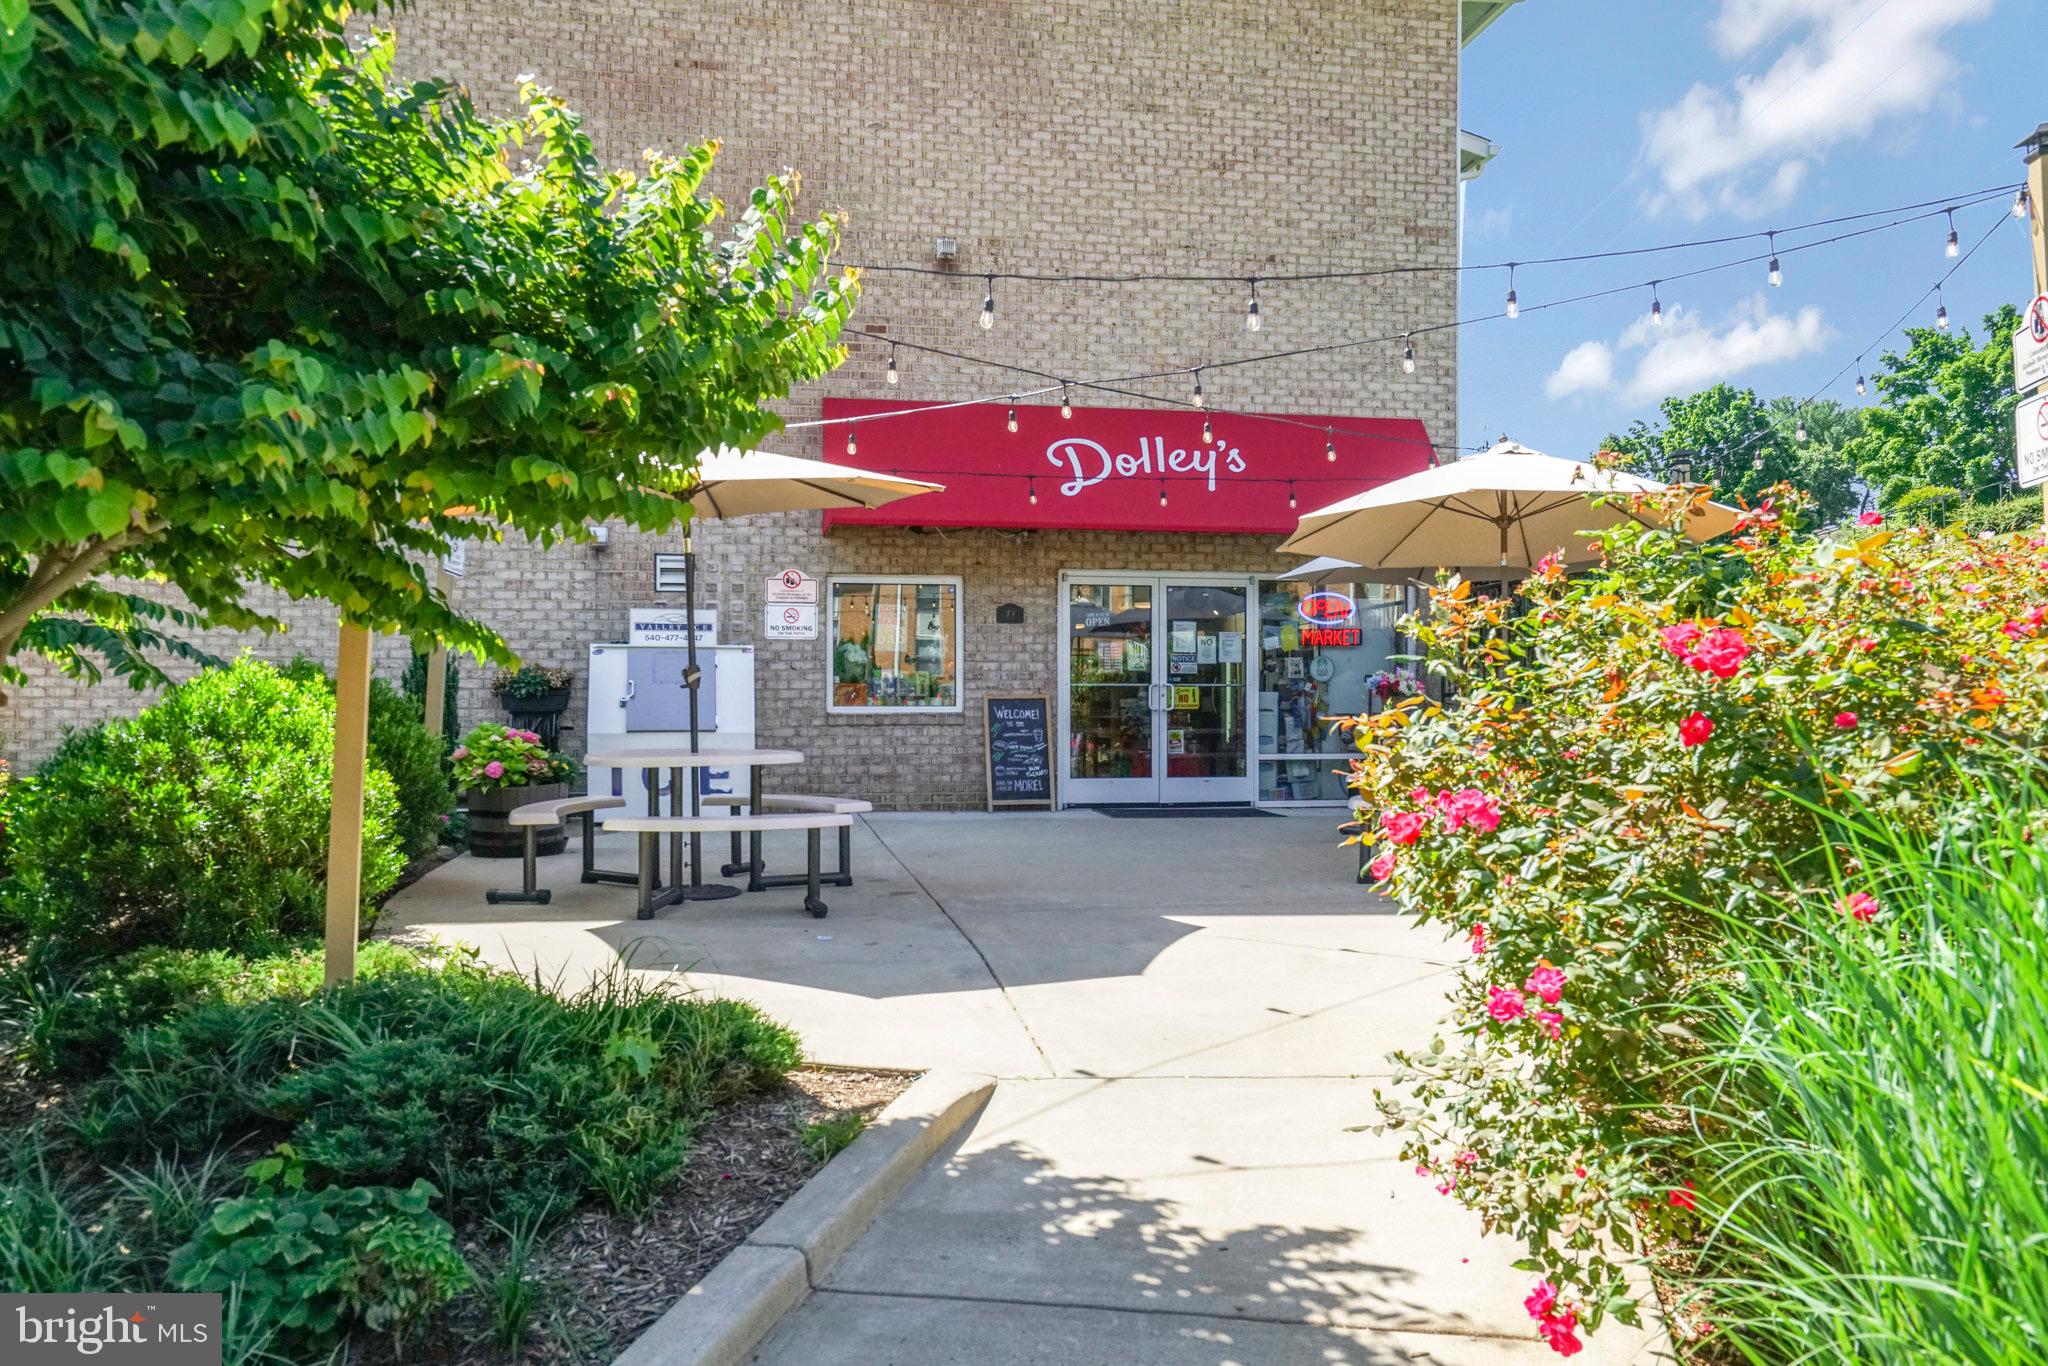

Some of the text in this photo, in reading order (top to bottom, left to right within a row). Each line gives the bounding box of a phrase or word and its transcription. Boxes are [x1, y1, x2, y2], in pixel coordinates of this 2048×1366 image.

[1046, 436, 1246, 497] Dolley's
[2024, 451, 2034, 469] NO
[1302, 598, 1351, 620] OPEN
[640, 623, 682, 631] VALLEY
[1085, 617, 1110, 627] OPEN
[1201, 638, 1213, 646] NO
[1301, 629, 1360, 646] MARKET
[993, 705, 1040, 720] WELCOME!
[1014, 780, 1043, 791] MORE!
